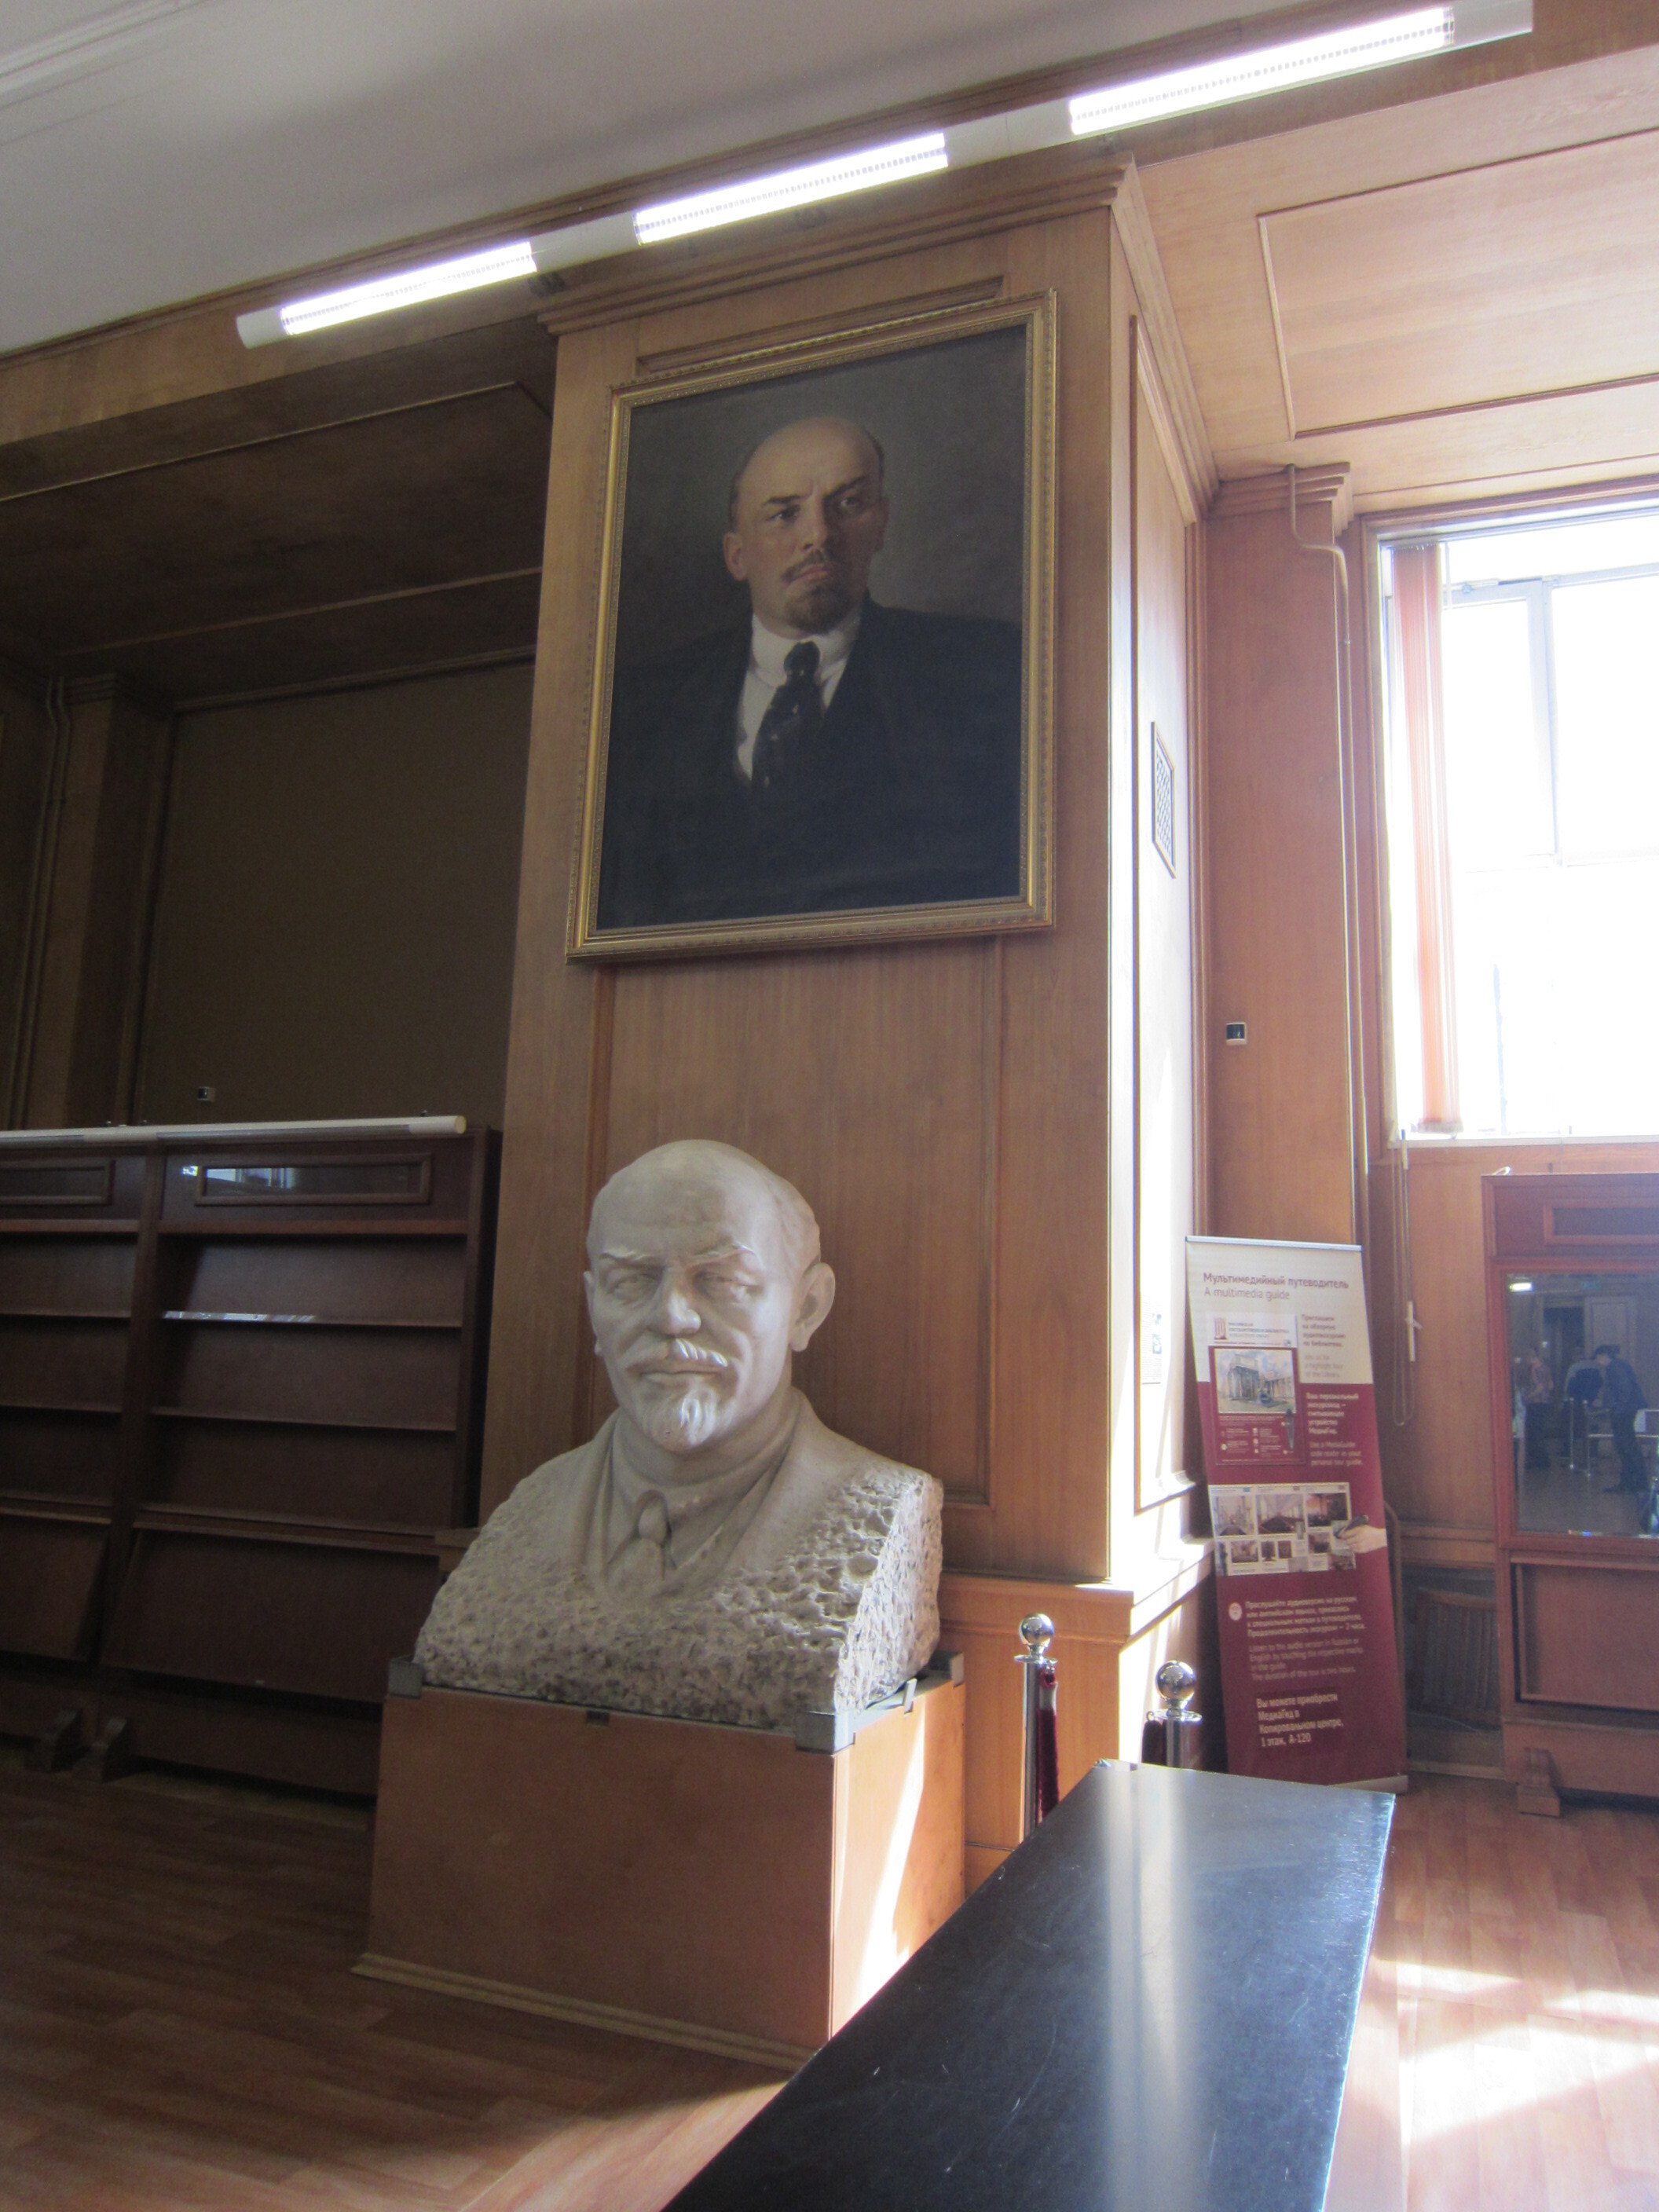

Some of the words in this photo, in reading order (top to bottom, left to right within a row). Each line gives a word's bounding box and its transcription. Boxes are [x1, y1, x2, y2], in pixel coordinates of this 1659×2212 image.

[1203, 1272, 1285, 1287] Мультимедийный
[1287, 1277, 1349, 1289] путеводитель
[1203, 1287, 1211, 1296] A
[1214, 1287, 1263, 1298] multimedia
[1265, 1290, 1290, 1302] guide
